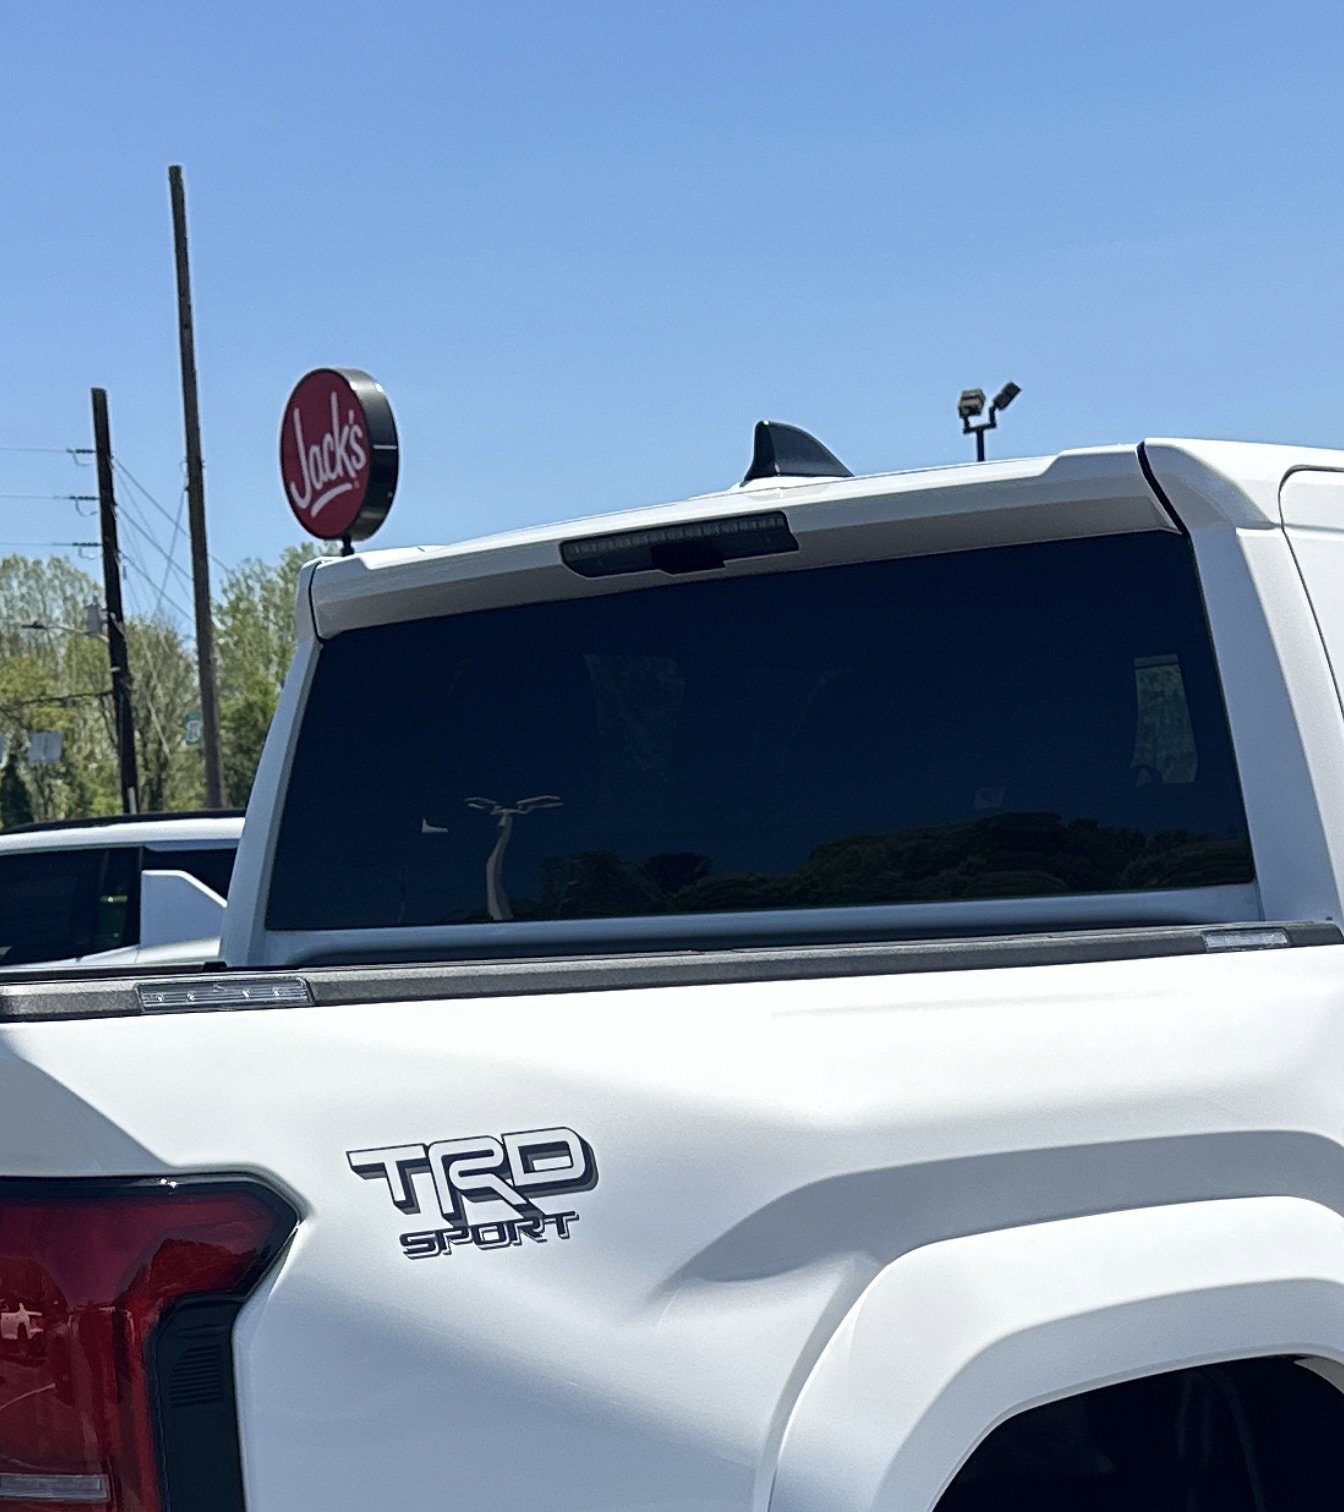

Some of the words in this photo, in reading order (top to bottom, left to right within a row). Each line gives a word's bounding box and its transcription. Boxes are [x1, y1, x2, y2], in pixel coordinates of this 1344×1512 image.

[289, 391, 366, 509] Jack's
[345, 1125, 600, 1229] TRD
[399, 1210, 580, 1260] SPORT
